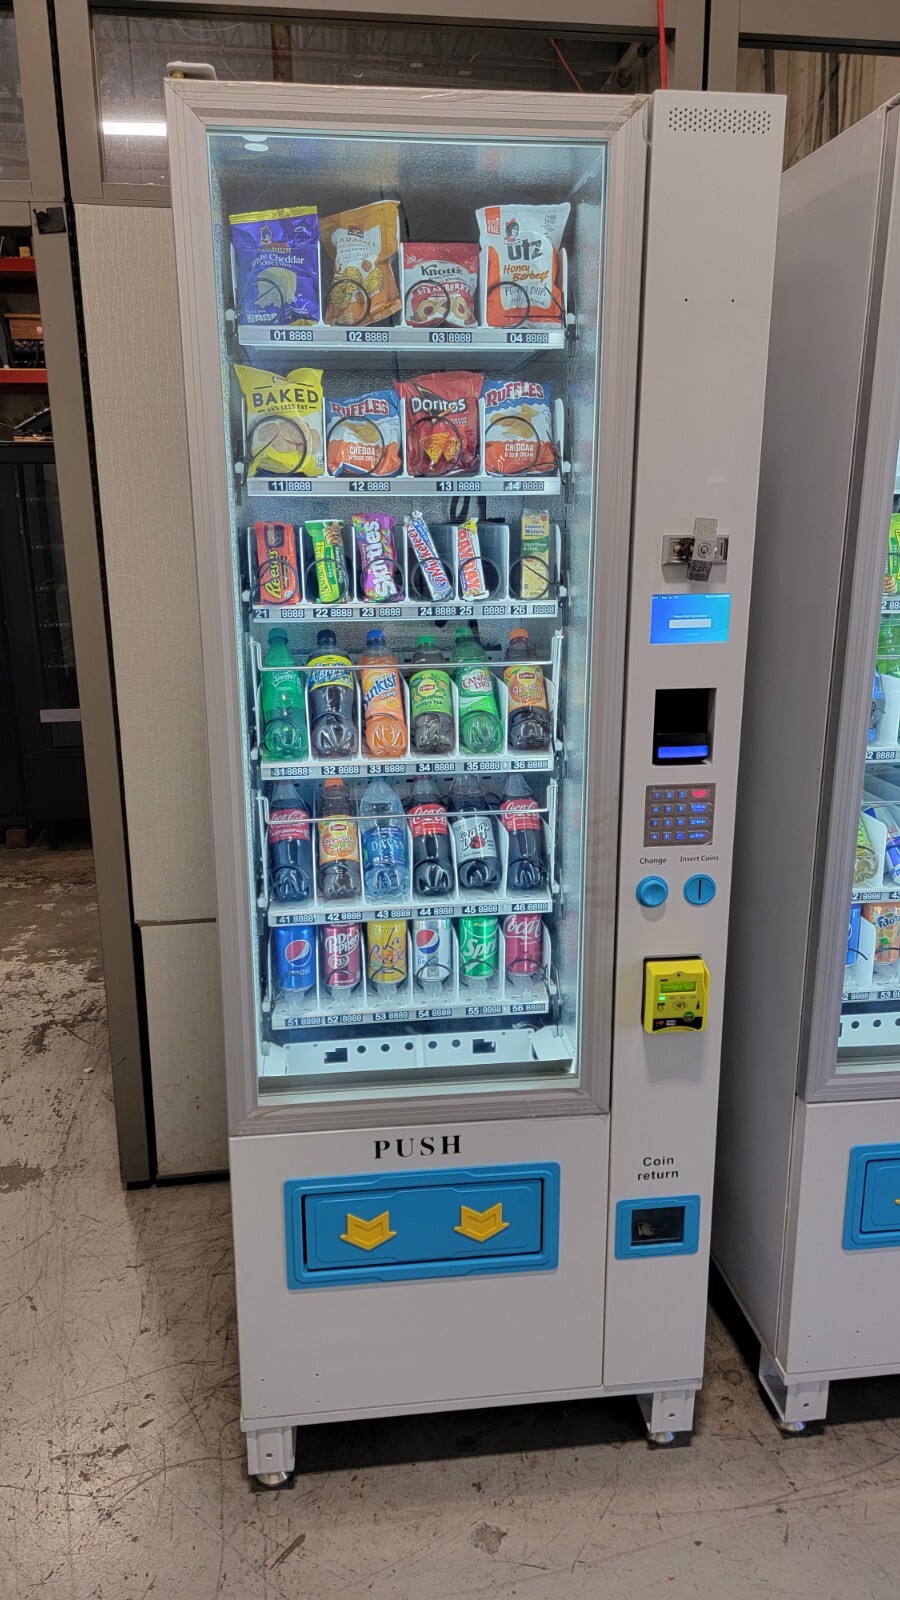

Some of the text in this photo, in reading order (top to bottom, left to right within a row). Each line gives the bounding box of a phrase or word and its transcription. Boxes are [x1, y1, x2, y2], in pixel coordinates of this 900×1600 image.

[487, 225, 500, 233] FREE
[507, 239, 542, 260] utz
[269, 253, 305, 265] Cheddar
[503, 264, 530, 275] Honey
[416, 283, 471, 296] STRABERRY
[273, 330, 313, 341] 01 8888
[349, 331, 388, 342] 02 8888
[432, 332, 471, 342] 03 8888
[510, 333, 548, 343] 04 8888
[252, 388, 319, 408] BAKED
[485, 381, 544, 408] RUFFLES
[330, 399, 390, 417] RUFFLES
[411, 396, 467, 413] Doritos
[505, 443, 534, 452] CHEDDAR
[271, 481, 311, 491] 11 8888
[352, 482, 389, 491] 12 8888
[439, 482, 480, 490] 13 8888
[508, 482, 544, 490] 14 8888
[364, 519, 398, 598] Skittles
[325, 555, 333, 578] CRUNCY
[263, 548, 282, 599] Reese's
[433, 577, 448, 588] 3
[513, 605, 555, 614] 26 8888
[881, 601, 888, 610] 2
[255, 610, 304, 618] 21 8888
[315, 608, 353, 617] 22 8888
[362, 608, 401, 617] 23 8888
[420, 606, 456, 615] 24 8888
[459, 606, 505, 615] 25 8888
[366, 672, 398, 702] unkist
[369, 764, 405, 773] 33 8888
[418, 763, 455, 772] 34 8888
[466, 762, 479, 770] 35
[513, 760, 548, 769] 36 8888
[273, 767, 308, 776] 31 8888
[323, 766, 359, 775] 32 8888
[504, 801, 539, 820] Coca-Co
[412, 806, 447, 825] Coca-Co
[887, 825, 899, 834] ull
[459, 819, 490, 852] Barq's
[639, 857, 668, 866] Change
[680, 854, 720, 863] Insert Coins
[419, 907, 454, 916] 44 8888
[464, 905, 498, 914] 45 8888
[527, 903, 548, 911] 8888
[279, 916, 290, 924] 41
[327, 912, 362, 921] 42 8888
[876, 914, 900, 929] Fant
[337, 933, 351, 944] Dr
[382, 926, 400, 950] La
[327, 934, 358, 955] Pepper
[462, 938, 498, 959] Spri
[842, 993, 849, 1001] 2
[418, 1009, 452, 1018] 54 8888
[468, 1007, 480, 1015] 55
[287, 1018, 298, 1026] 51
[327, 1016, 339, 1024] 52
[373, 1134, 462, 1160] PUSH
[642, 1155, 675, 1168] Coin
[637, 1168, 680, 1182] return
